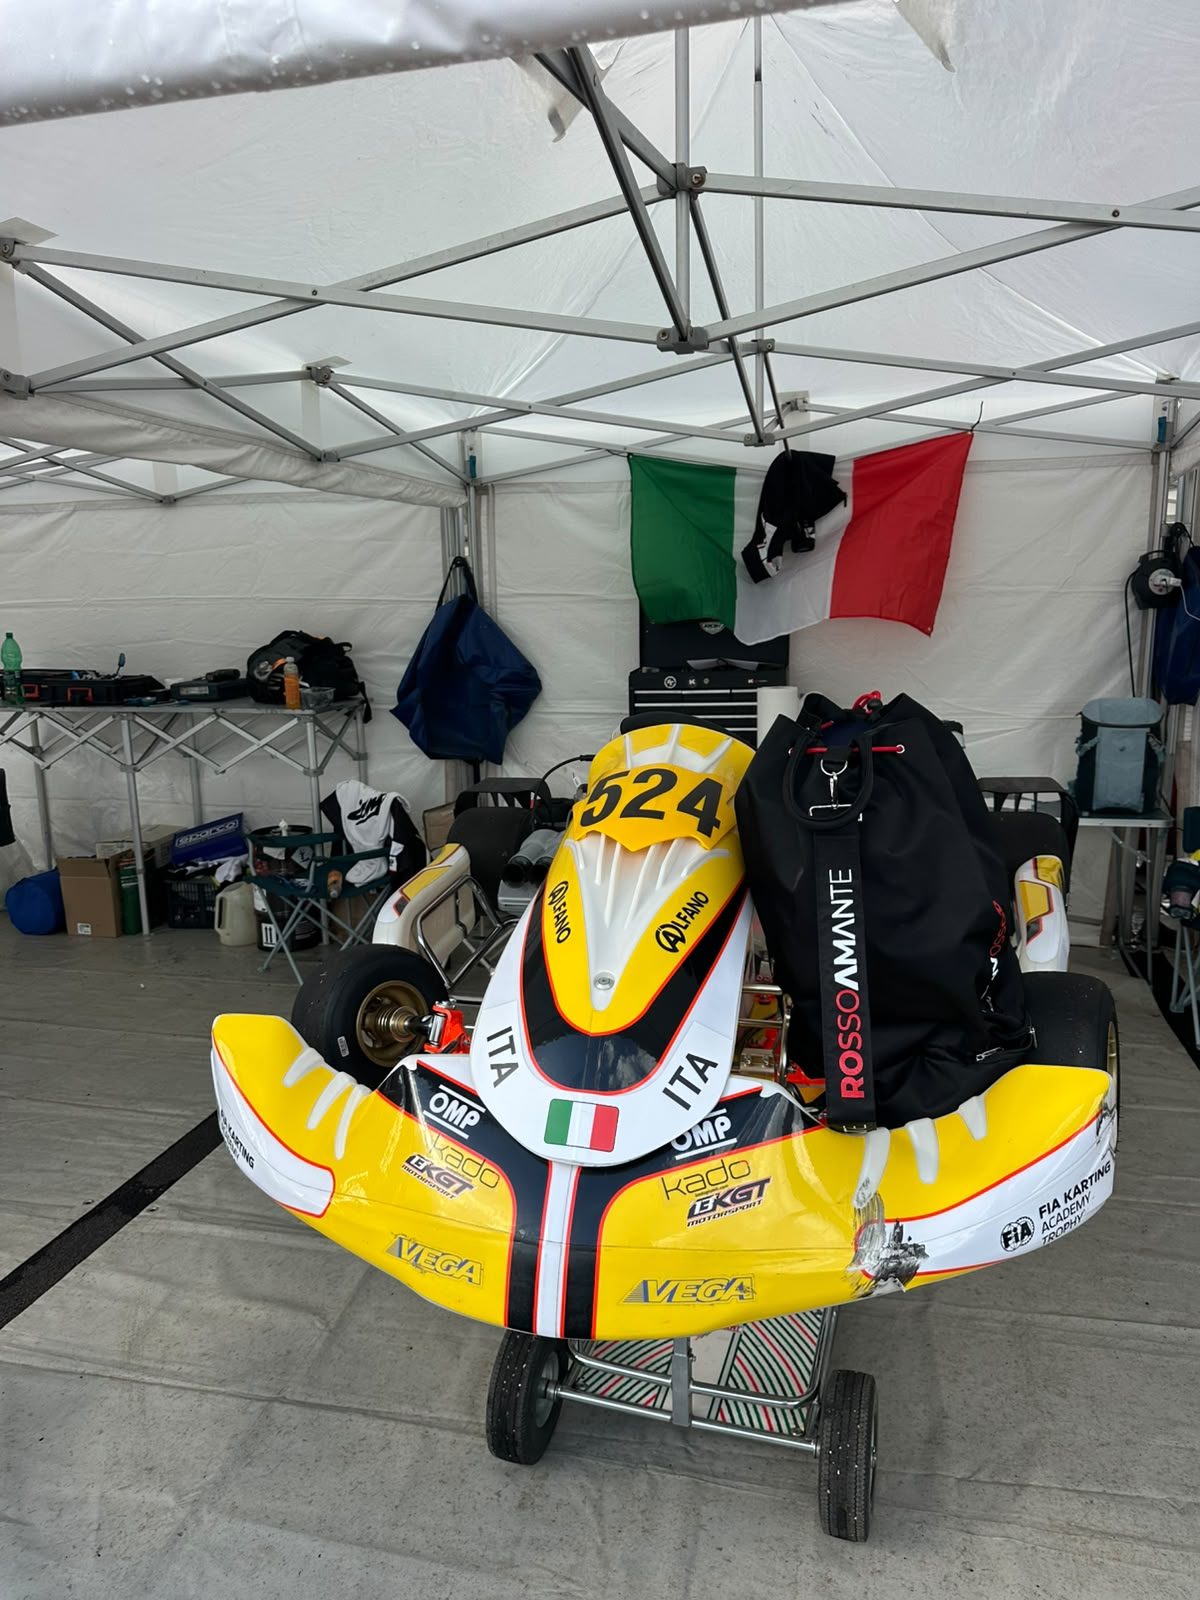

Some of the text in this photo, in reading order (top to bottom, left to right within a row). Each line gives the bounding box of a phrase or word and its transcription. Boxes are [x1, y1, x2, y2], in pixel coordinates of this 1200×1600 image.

[580, 768, 724, 838] 524
[549, 880, 571, 944] ALFANO
[655, 891, 709, 953] ALFANO
[486, 1025, 519, 1088] ITA
[662, 1053, 719, 1111] ITA
[429, 1092, 481, 1130] OMP
[401, 1164, 456, 1199] MOTORSPORT
[429, 1134, 500, 1189] kado
[661, 1159, 751, 1201] kado
[687, 1200, 763, 1227] MOTORSPORT
[1039, 1161, 1111, 1219] FIA KARTING
[1041, 1191, 1092, 1234] ACADEMY
[1042, 1208, 1086, 1245] TROPHY
[391, 1236, 484, 1286] VEGA
[633, 1276, 755, 1304] VEGA
